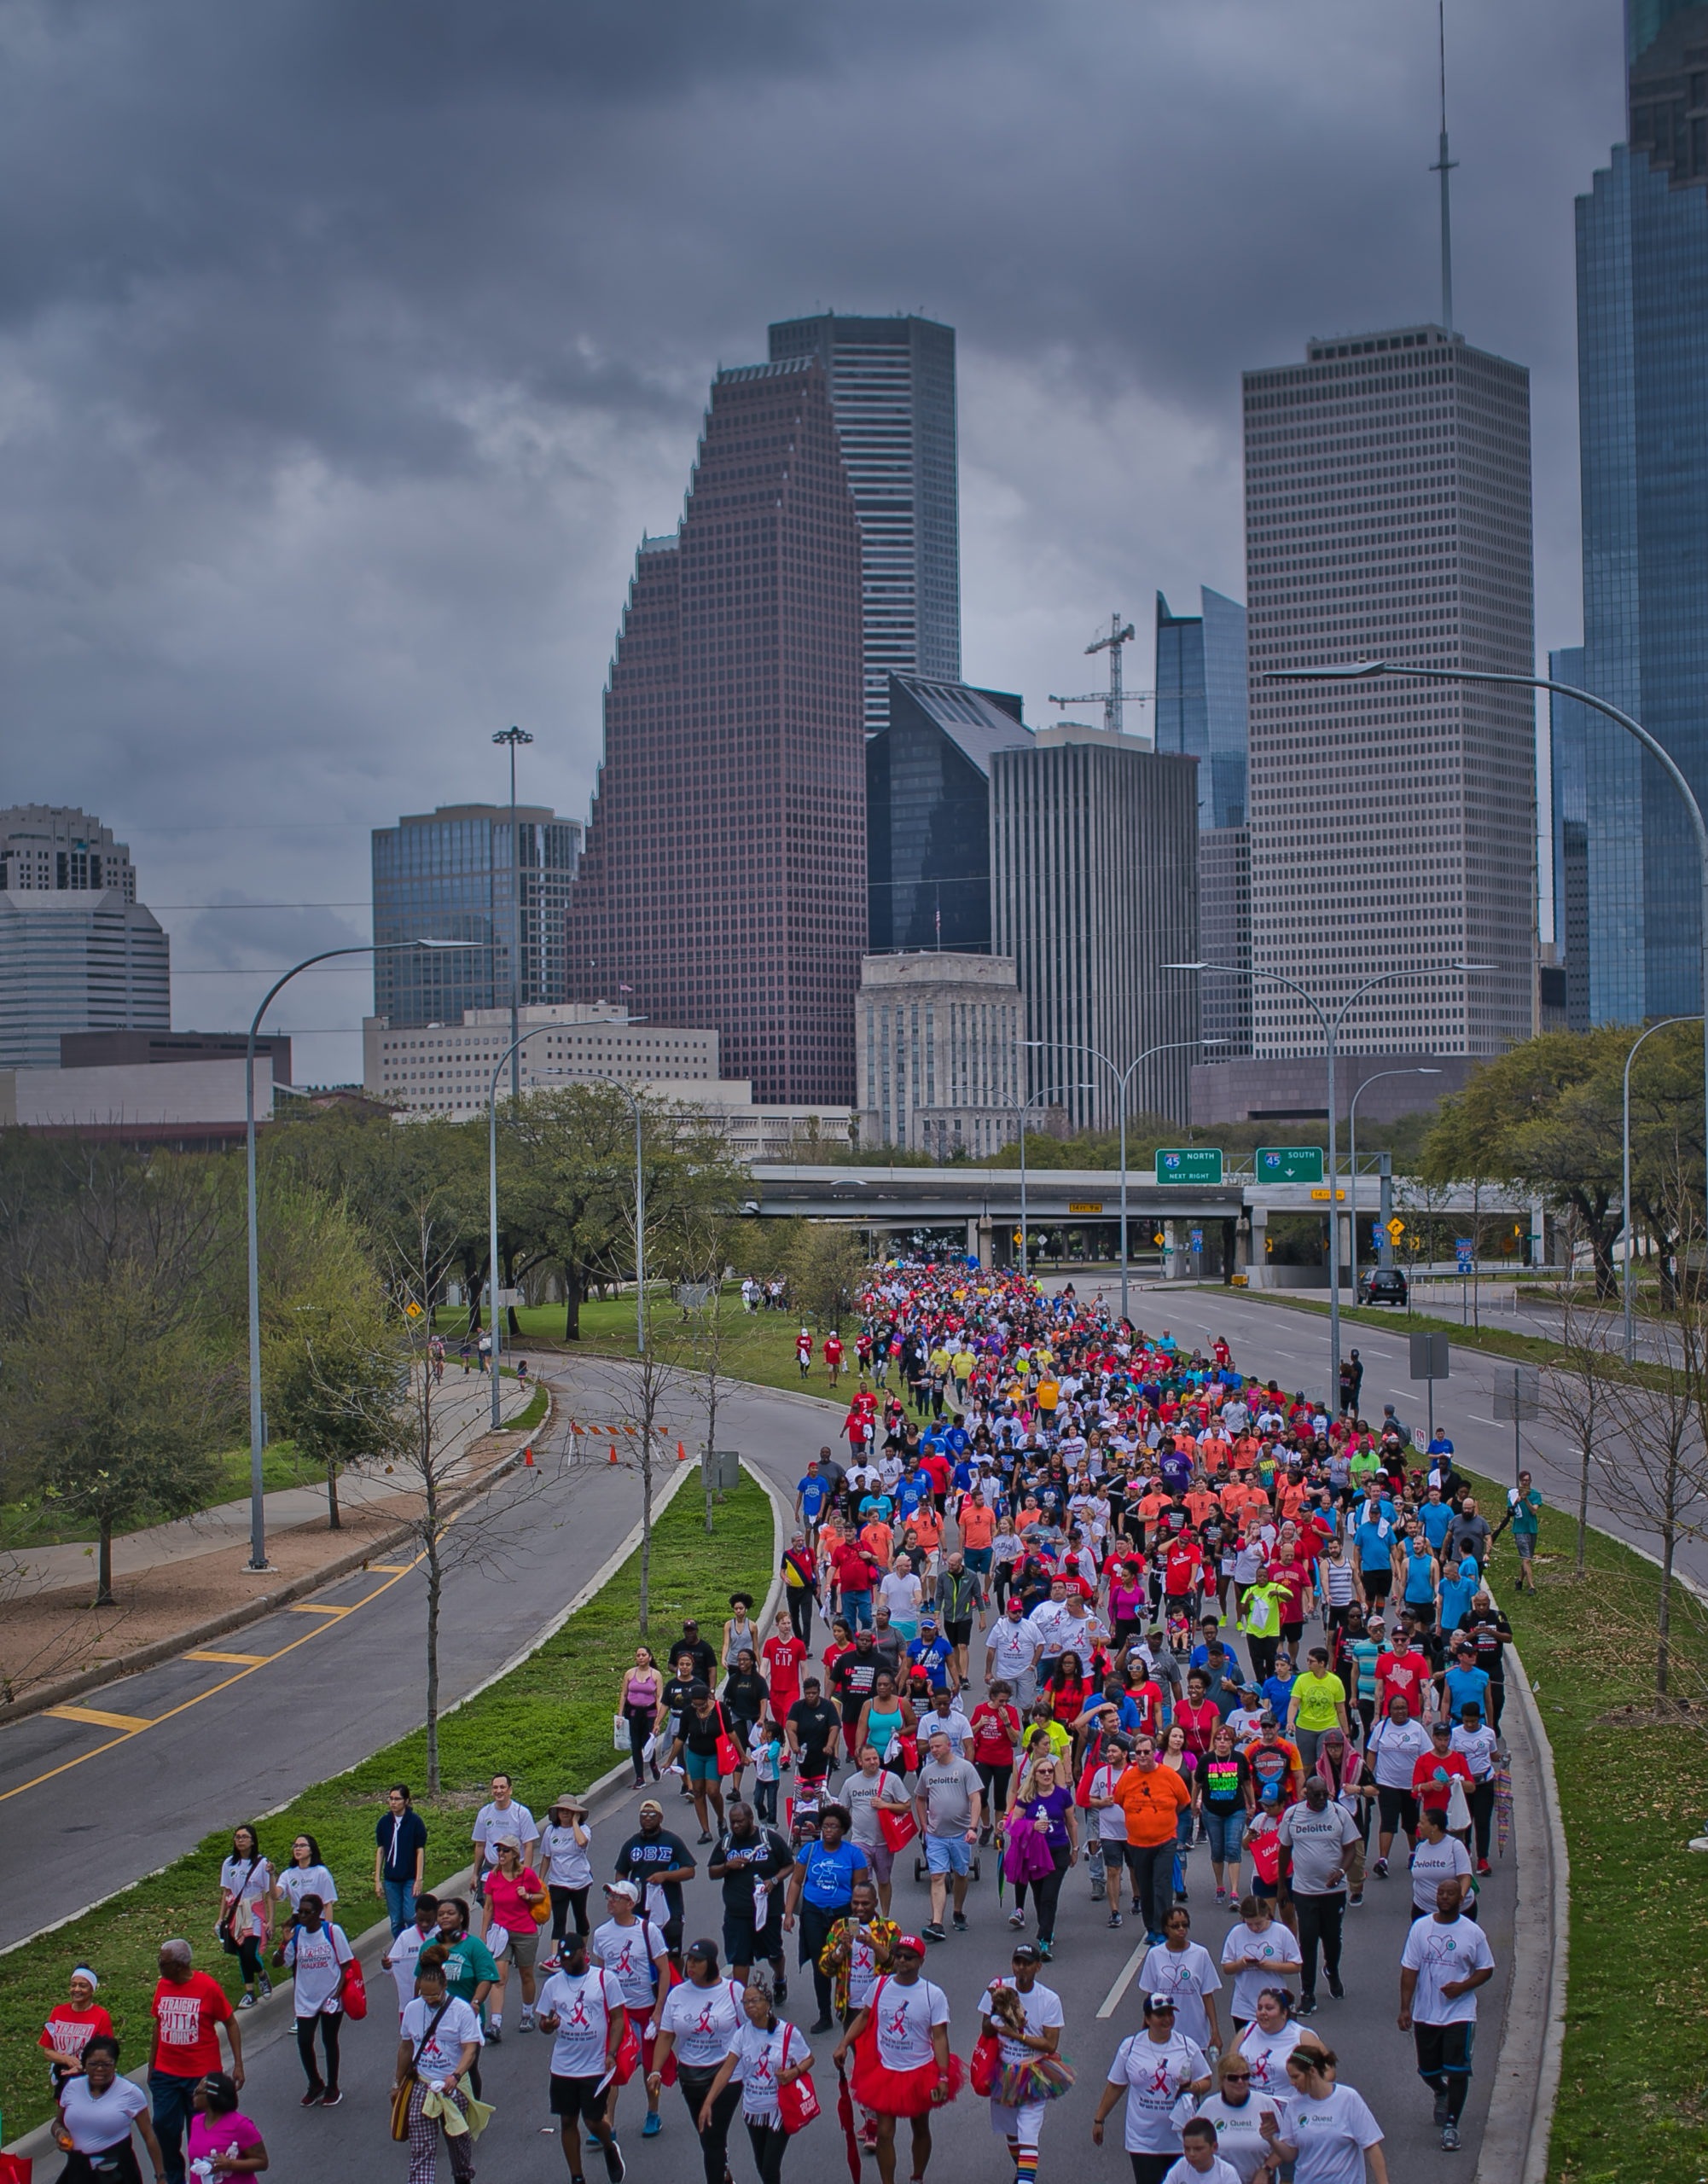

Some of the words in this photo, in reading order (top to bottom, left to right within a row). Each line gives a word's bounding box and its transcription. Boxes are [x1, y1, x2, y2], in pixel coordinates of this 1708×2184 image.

[1165, 1157, 1181, 1167] 45
[1266, 1156, 1281, 1166] 45
[1459, 1250, 1472, 1260] 45
[776, 1653, 793, 1666] GAP
[852, 1788, 879, 1798] Deloitt
[159, 2013, 198, 2030] OUTTA
[171, 2030, 198, 2044] JOHN'S
[796, 2078, 811, 2100] 1
[1229, 2119, 1252, 2128] Quest
[1311, 2115, 1333, 2123] Quest
